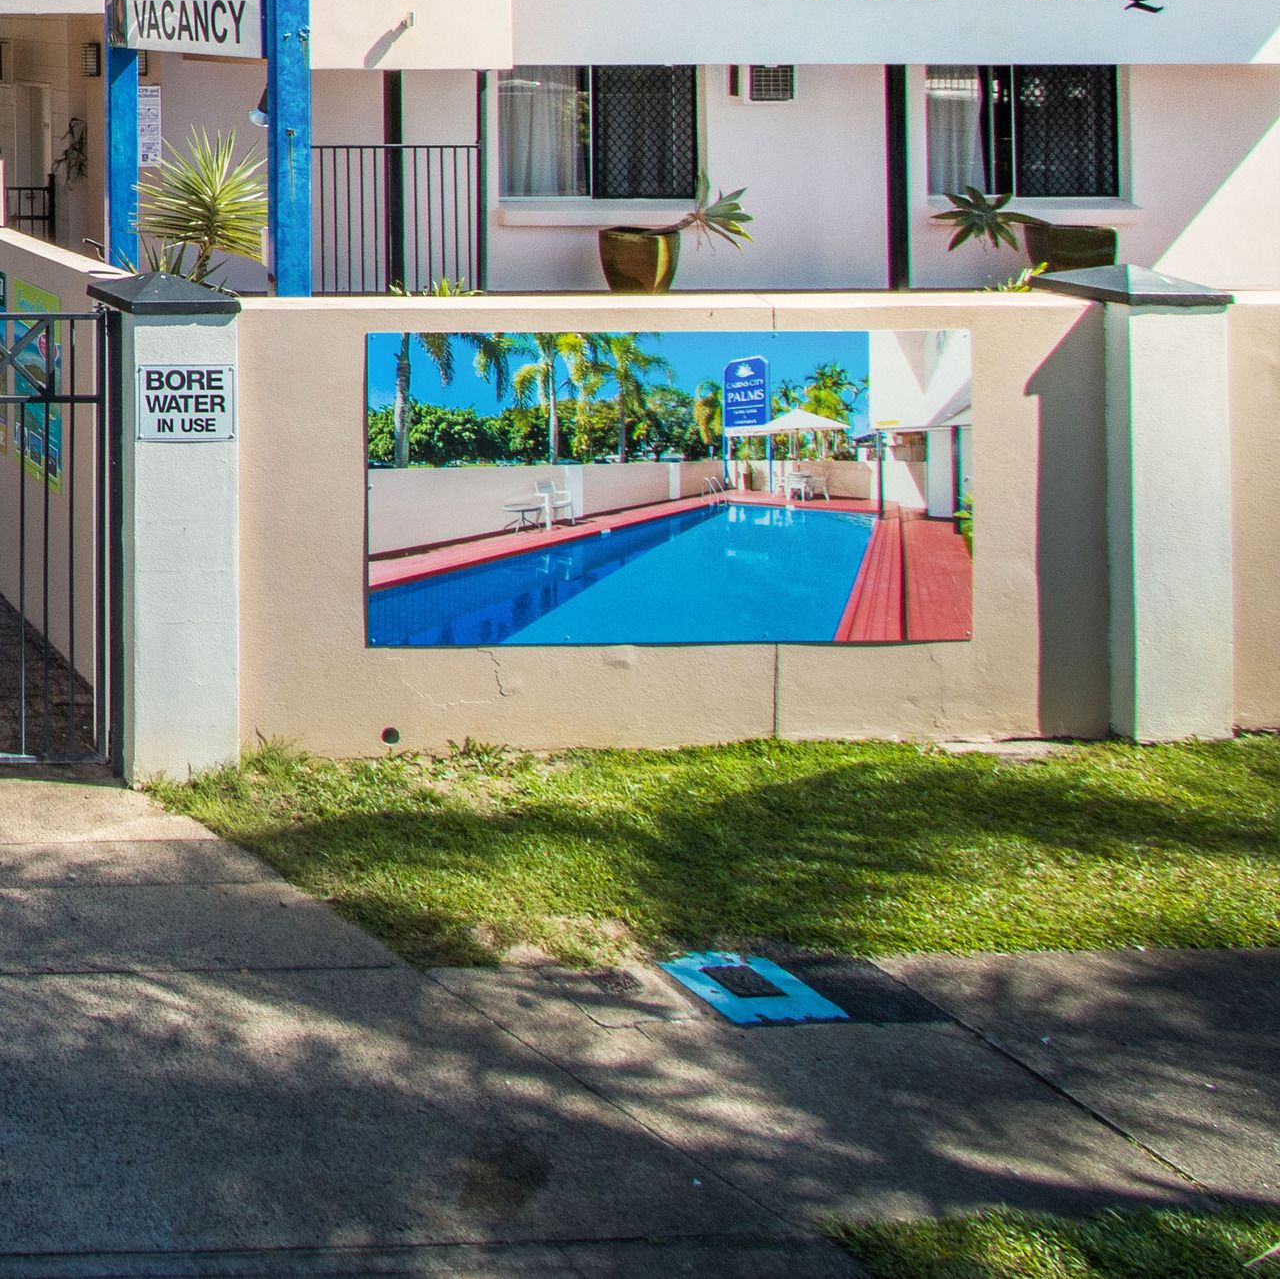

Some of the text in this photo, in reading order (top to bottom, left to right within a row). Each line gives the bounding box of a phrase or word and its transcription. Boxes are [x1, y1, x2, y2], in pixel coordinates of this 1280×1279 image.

[145, 369, 224, 391] BORE
[145, 394, 226, 414] WATER
[727, 388, 765, 403] PALMS
[156, 418, 217, 433] IN USE
